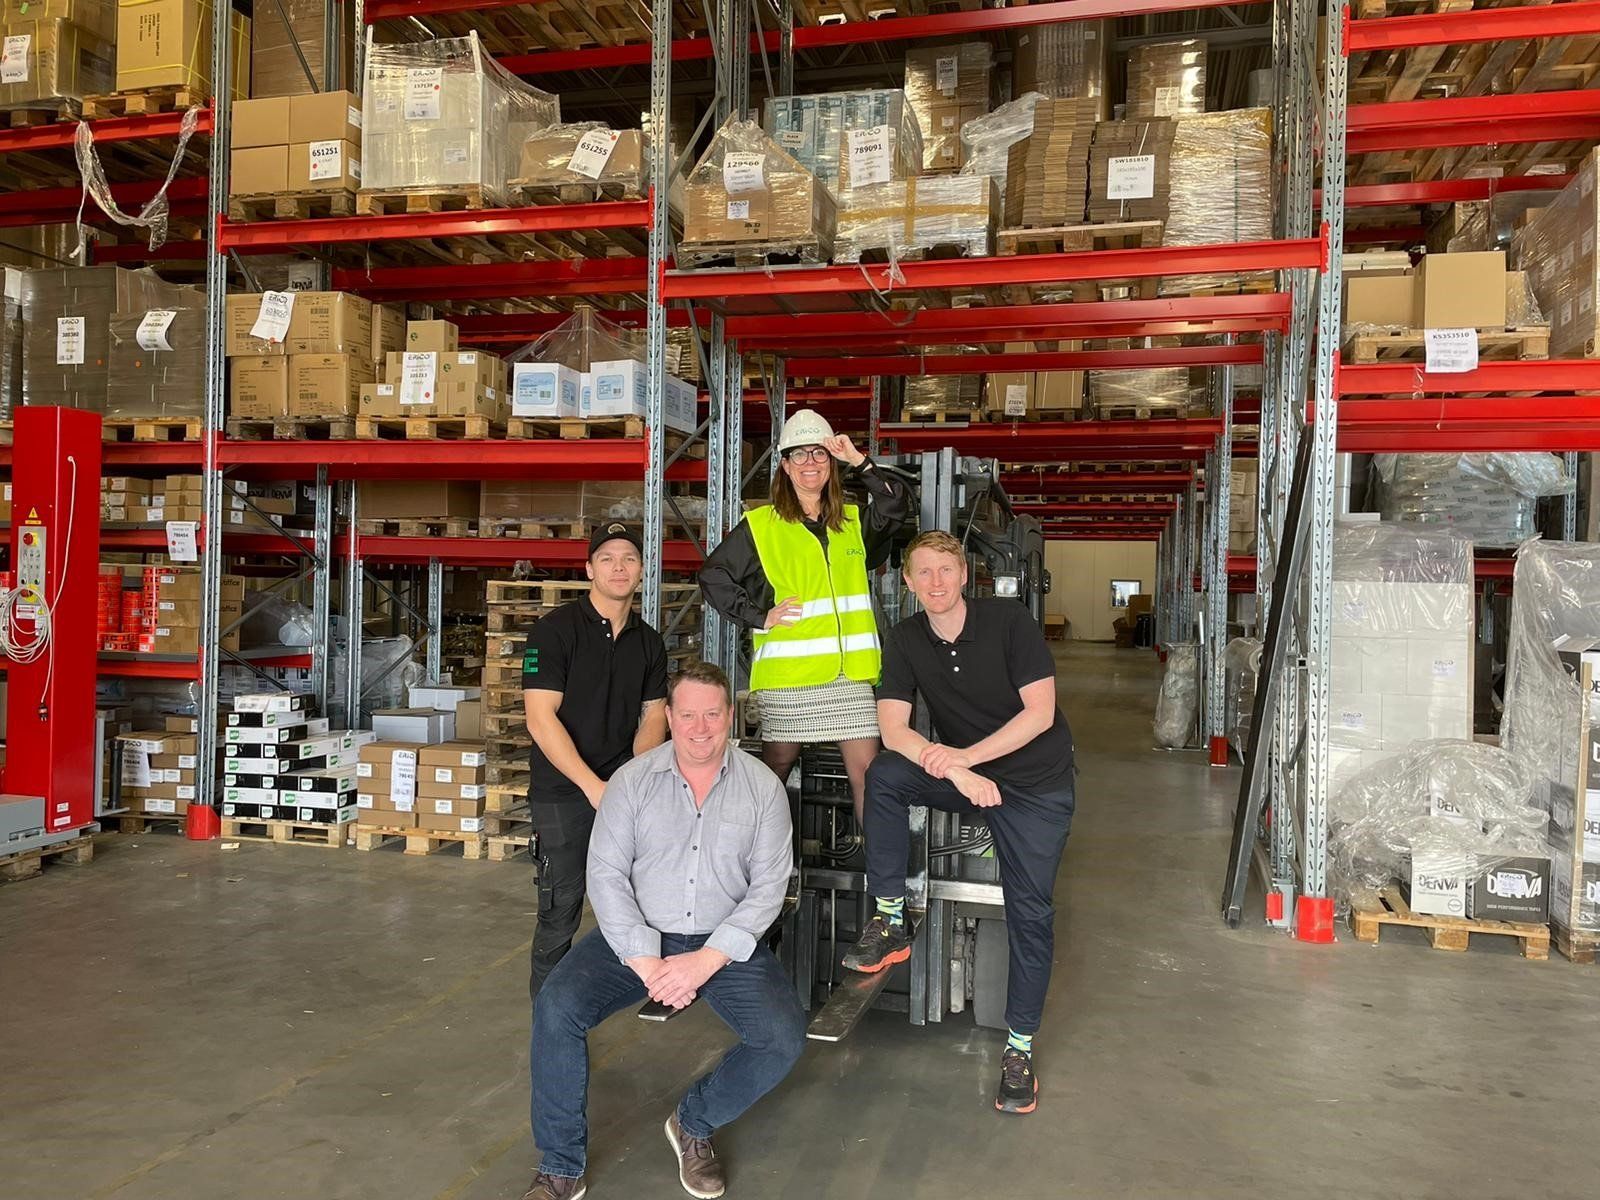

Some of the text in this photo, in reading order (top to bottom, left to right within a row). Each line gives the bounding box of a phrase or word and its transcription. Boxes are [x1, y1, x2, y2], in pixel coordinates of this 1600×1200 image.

[312, 147, 338, 157] 651251
[580, 141, 609, 156] 651255
[854, 143, 882, 154] 789091
[1418, 874, 1459, 891] DENVA
